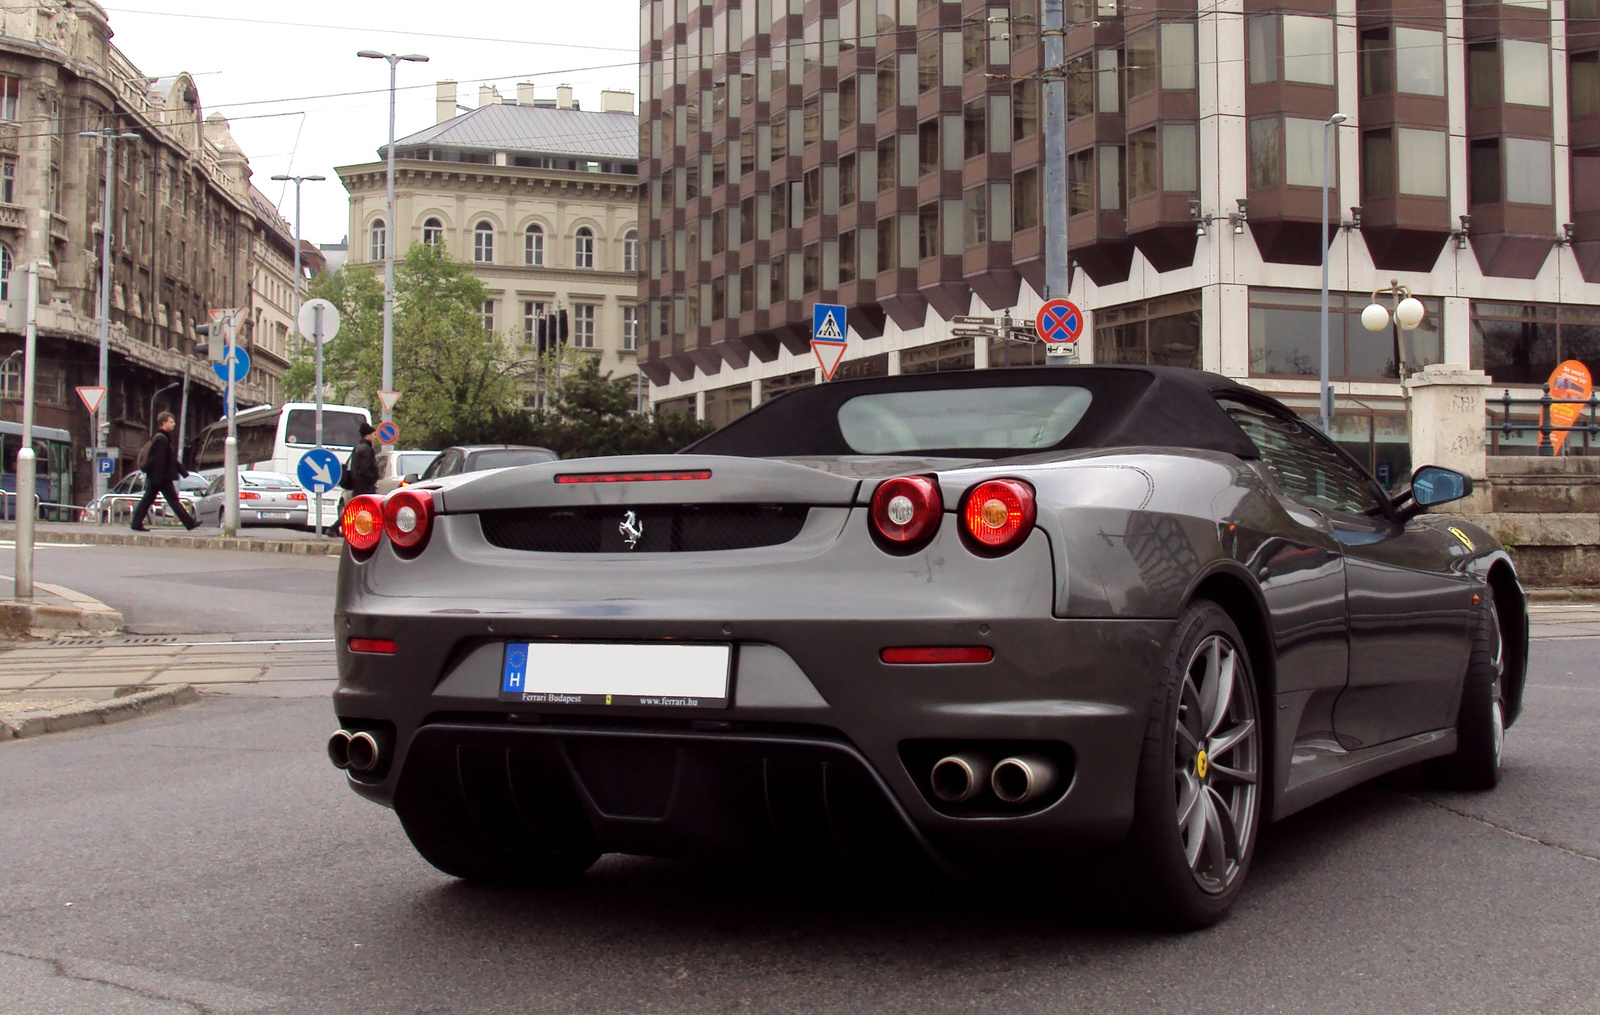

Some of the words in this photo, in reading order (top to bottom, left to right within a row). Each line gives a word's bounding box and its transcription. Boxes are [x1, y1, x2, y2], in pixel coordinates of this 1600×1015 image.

[102, 462, 110, 471] P
[509, 672, 520, 687] H
[522, 692, 547, 702] Ferrari
[548, 693, 581, 704] Budapest
[640, 697, 698, 706] www.ferrari.hu
